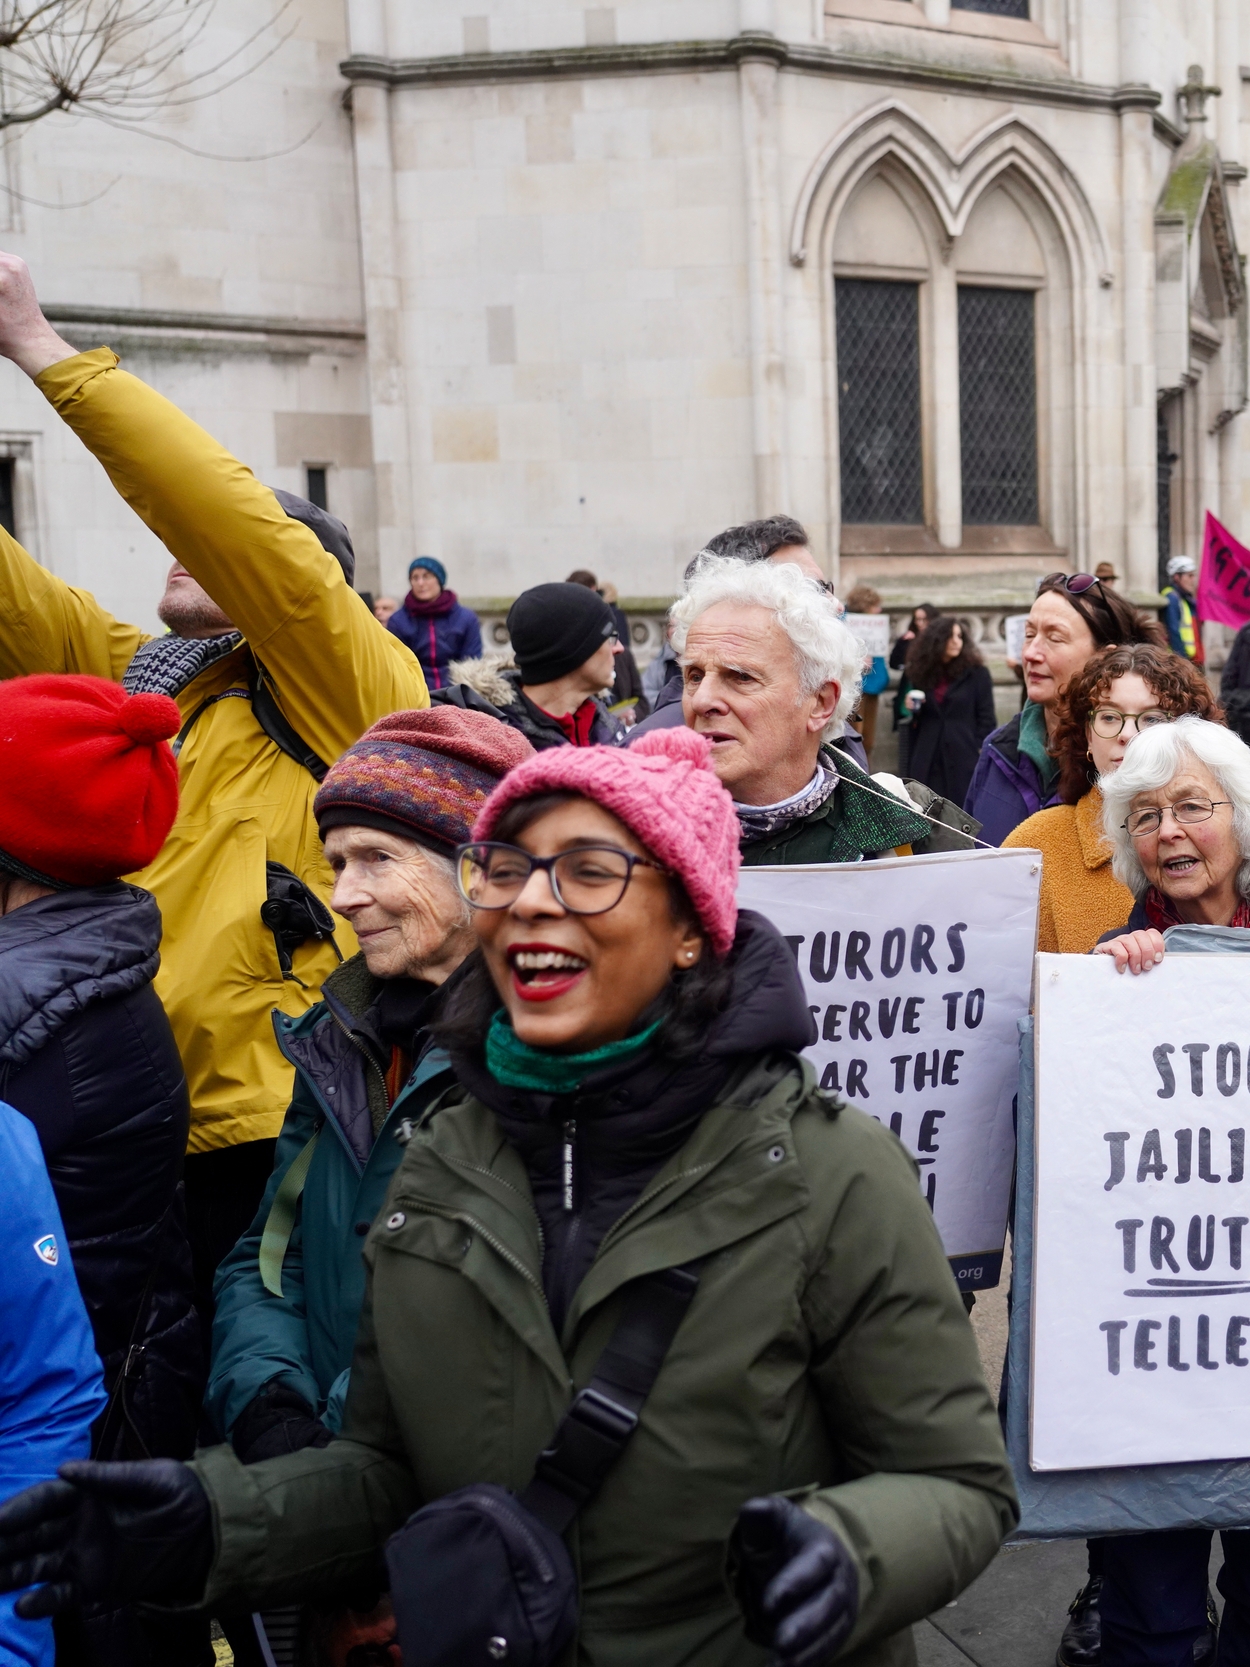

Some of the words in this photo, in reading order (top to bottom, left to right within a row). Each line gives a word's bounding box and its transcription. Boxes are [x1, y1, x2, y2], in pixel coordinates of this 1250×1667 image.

[806, 996, 926, 1047] SERVE
[942, 988, 985, 1032] TO
[819, 1058, 870, 1099] AR
[890, 1048, 965, 1094] THE
